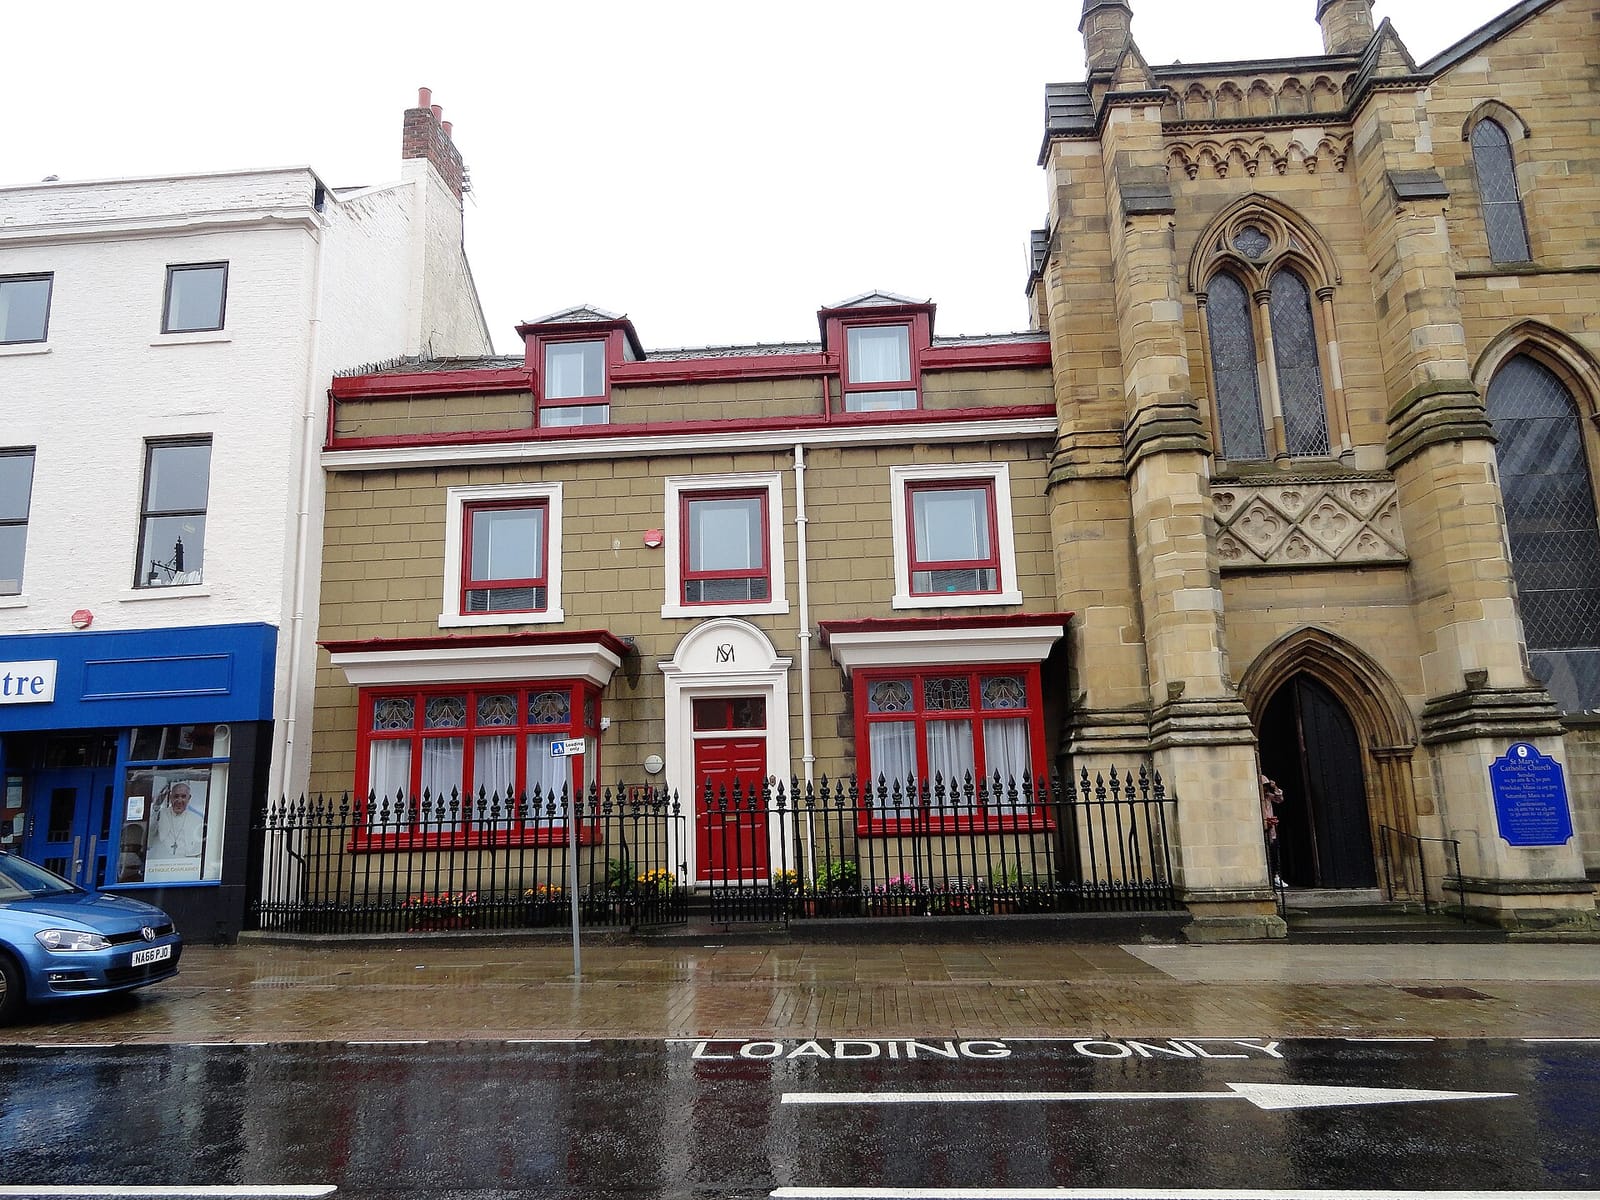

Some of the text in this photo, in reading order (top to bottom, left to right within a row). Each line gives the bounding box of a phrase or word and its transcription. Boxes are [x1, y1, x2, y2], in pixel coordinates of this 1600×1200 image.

[2, 671, 44, 696] tre
[135, 950, 155, 964] NA66
[691, 1039, 1283, 1059] LOADING ONLY
